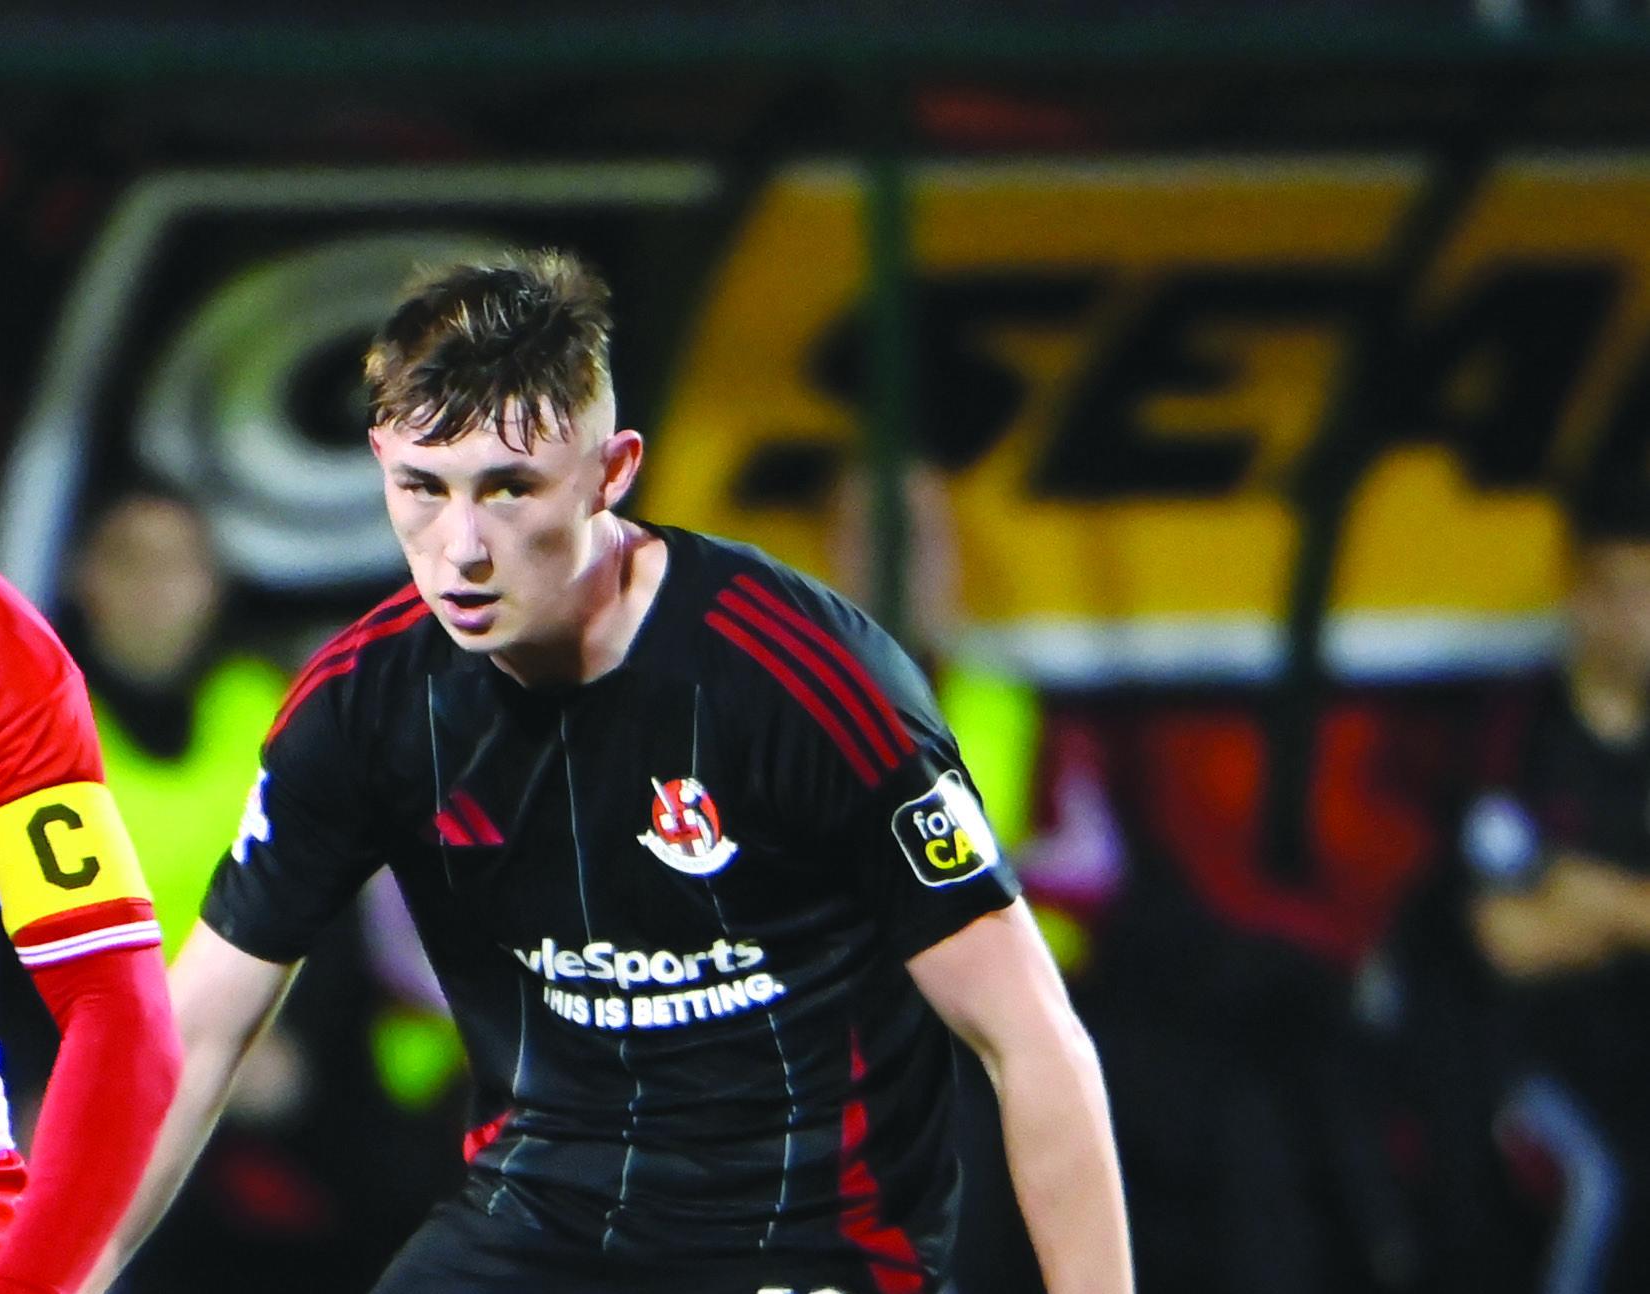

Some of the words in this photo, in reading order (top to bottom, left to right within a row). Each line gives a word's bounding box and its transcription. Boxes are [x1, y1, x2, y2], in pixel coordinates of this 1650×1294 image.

[26, 803, 100, 890] C
[925, 828, 976, 869] CA
[513, 937, 766, 990] yleSports
[594, 998, 628, 1028] IS
[632, 974, 786, 1028] BETTING.
